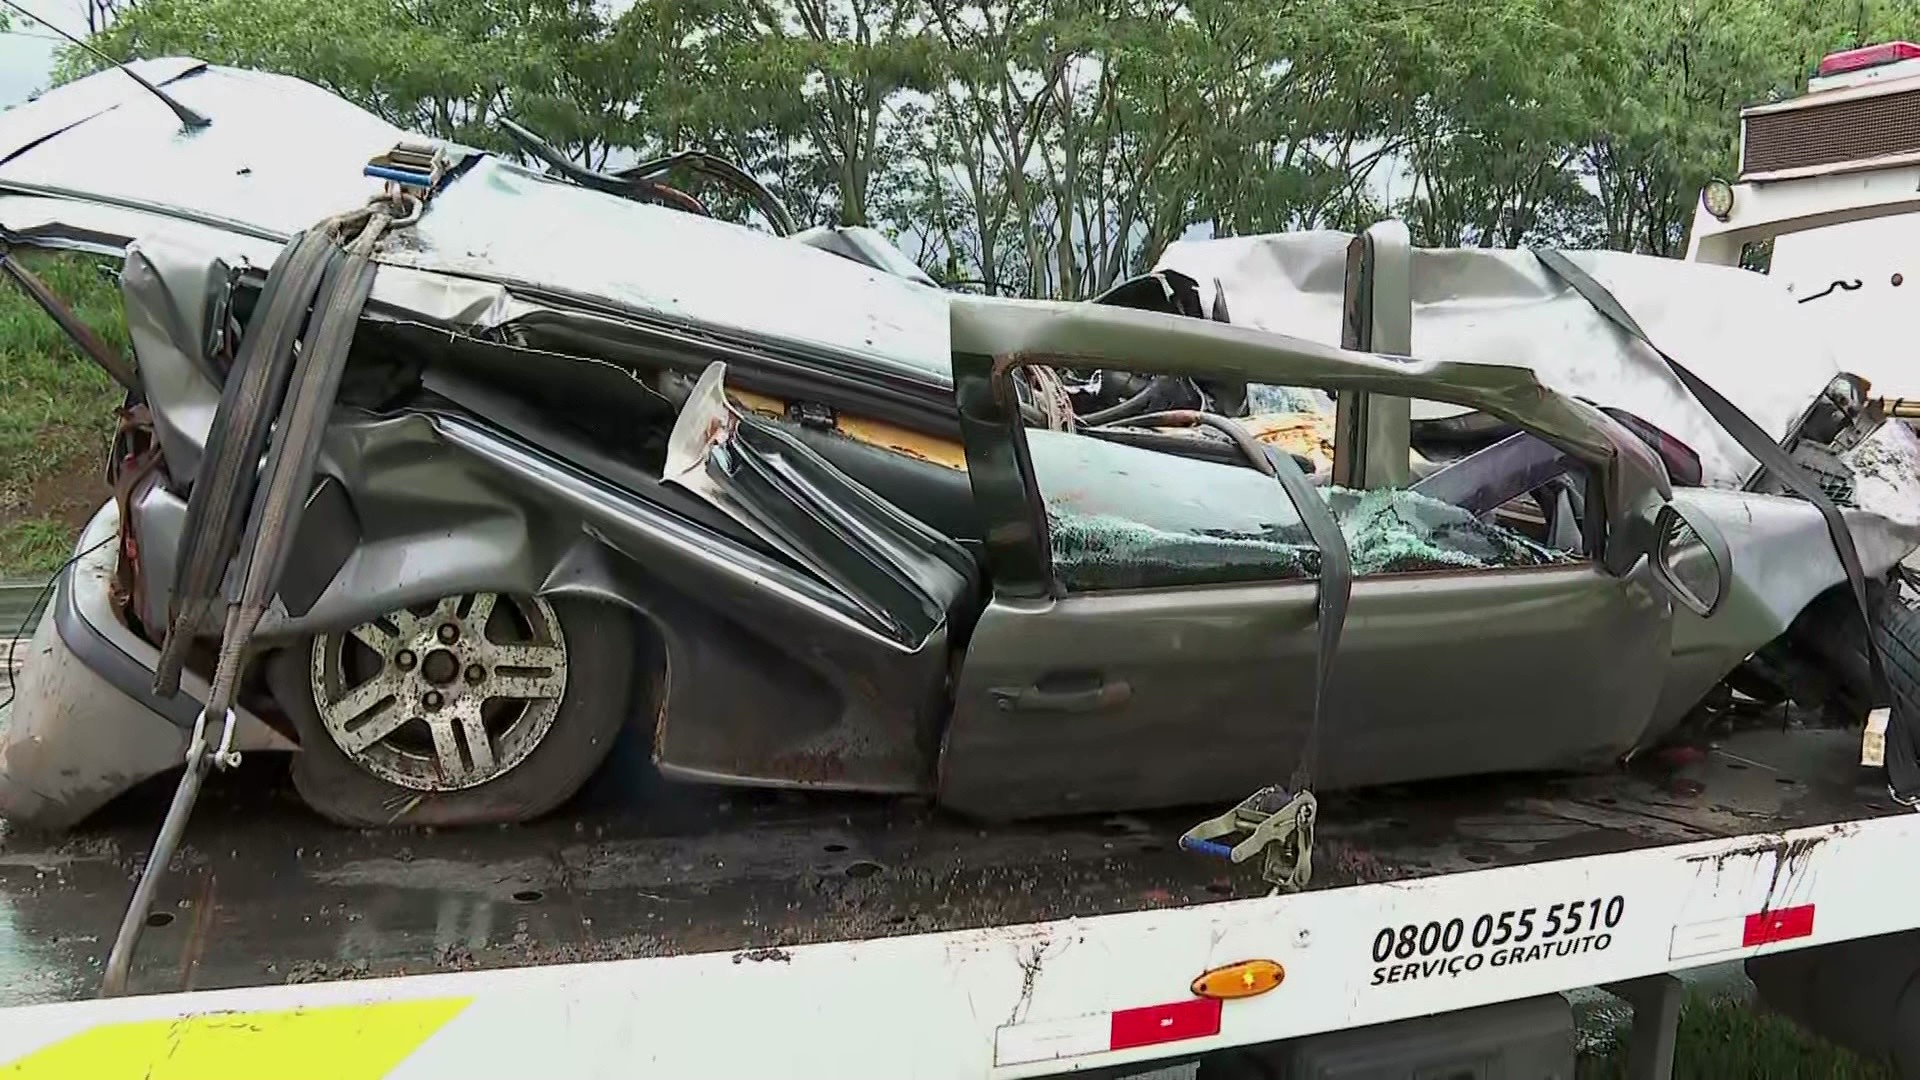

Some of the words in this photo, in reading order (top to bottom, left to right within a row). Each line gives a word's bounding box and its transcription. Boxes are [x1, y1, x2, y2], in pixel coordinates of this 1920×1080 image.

[1372, 917, 1464, 963] 0800
[1471, 907, 1537, 949] 055
[1541, 895, 1625, 938] 5510
[1370, 953, 1484, 986] SERVIÇO
[1490, 933, 1612, 967] GRATUITO
